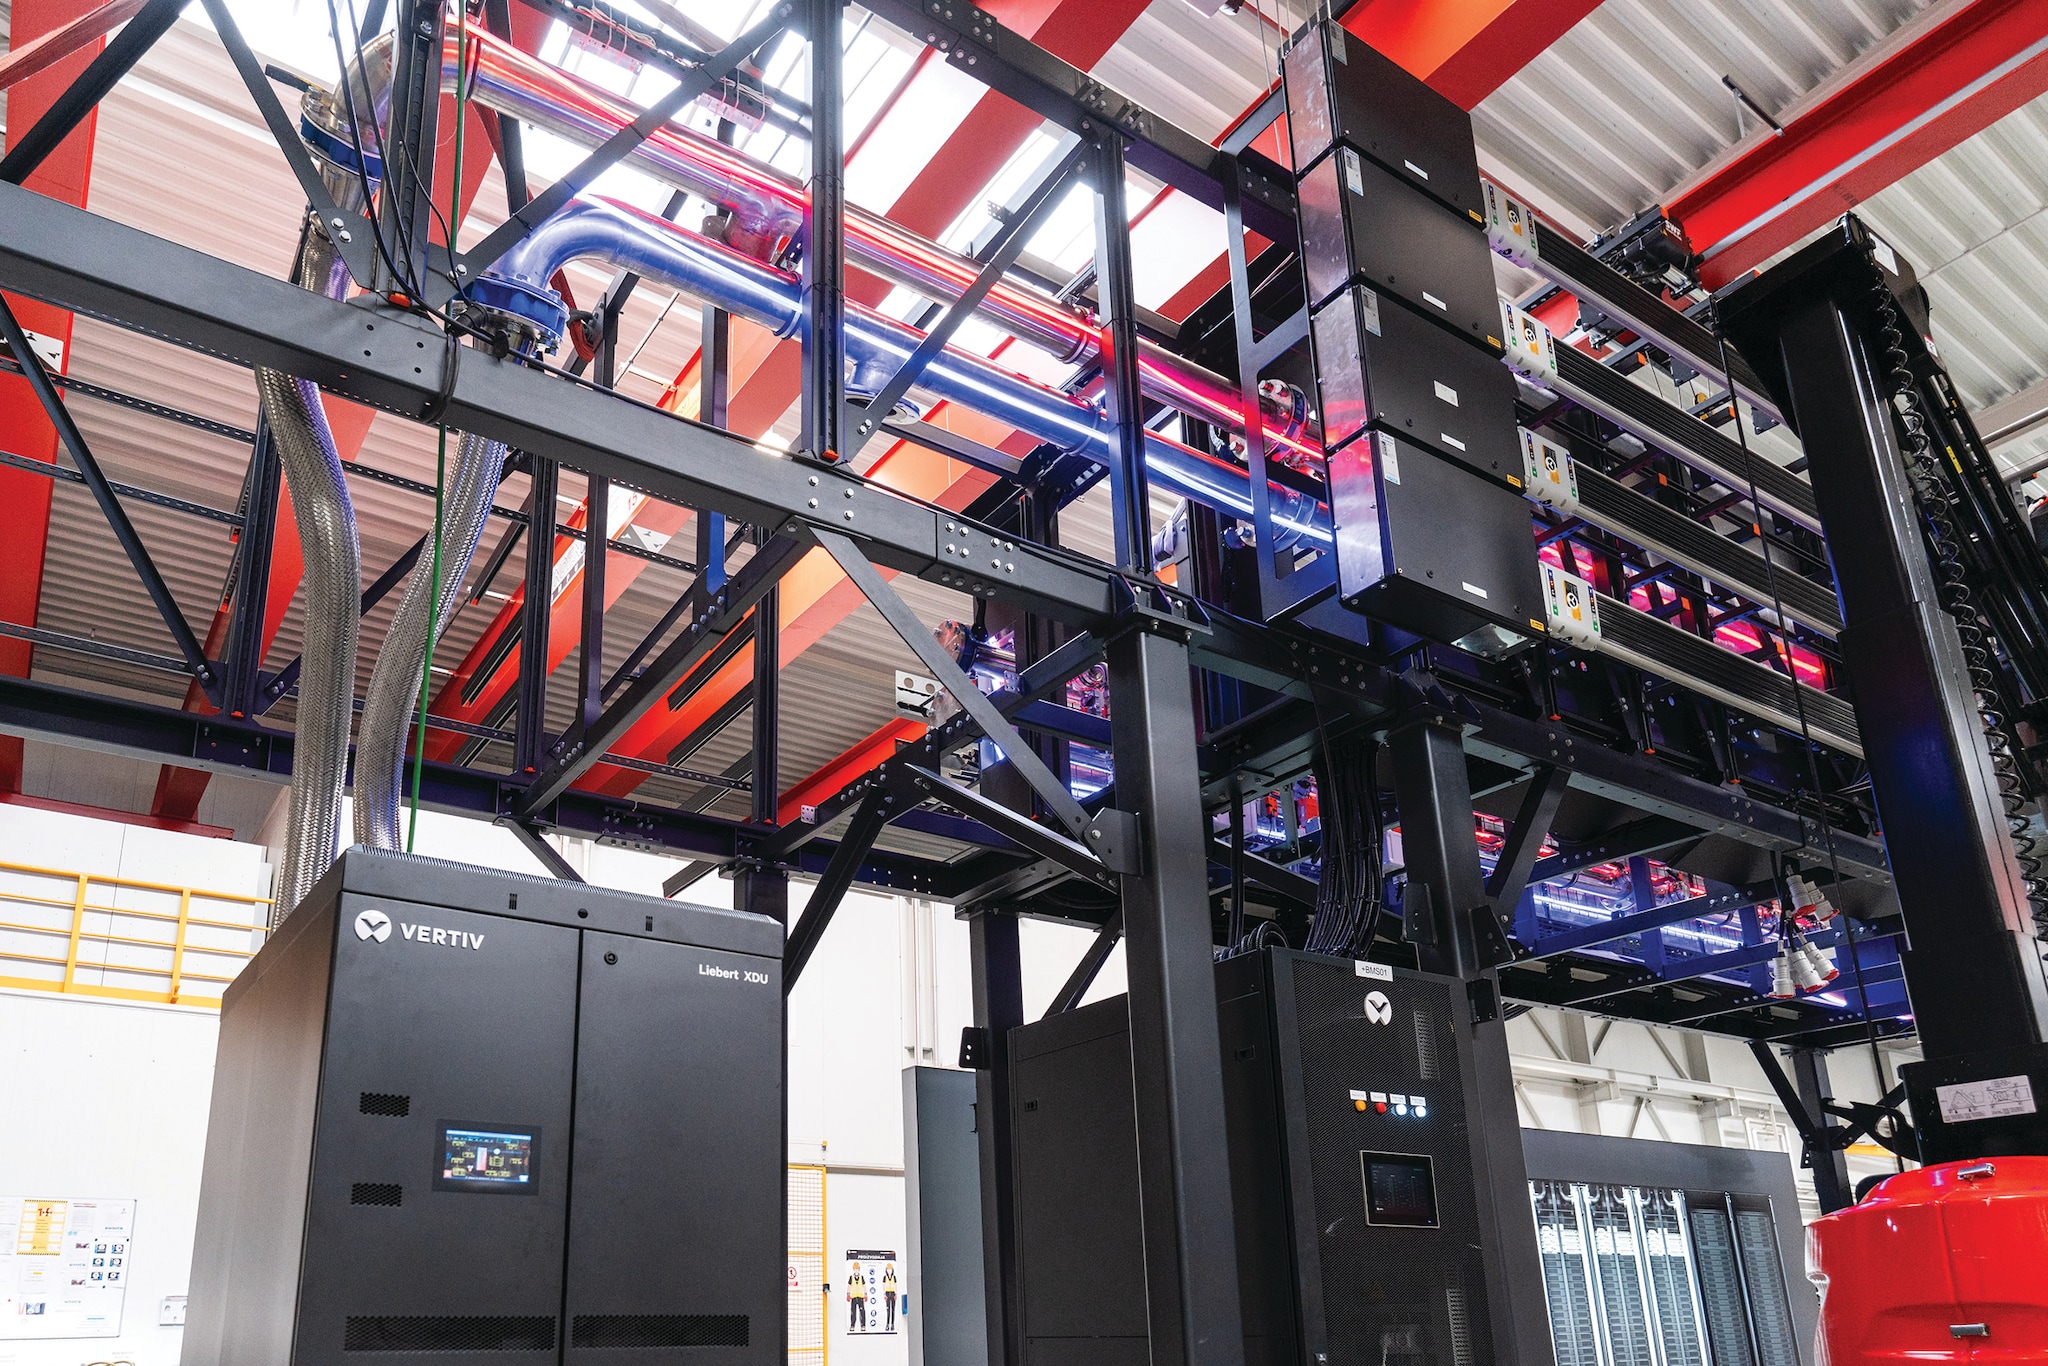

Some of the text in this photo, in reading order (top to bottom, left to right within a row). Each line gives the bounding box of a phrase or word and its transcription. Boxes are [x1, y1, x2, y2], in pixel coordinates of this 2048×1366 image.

[400, 922, 485, 950] VERTIV
[698, 963, 769, 984] Liebert XDU
[1361, 965, 1387, 977] +BMS01
